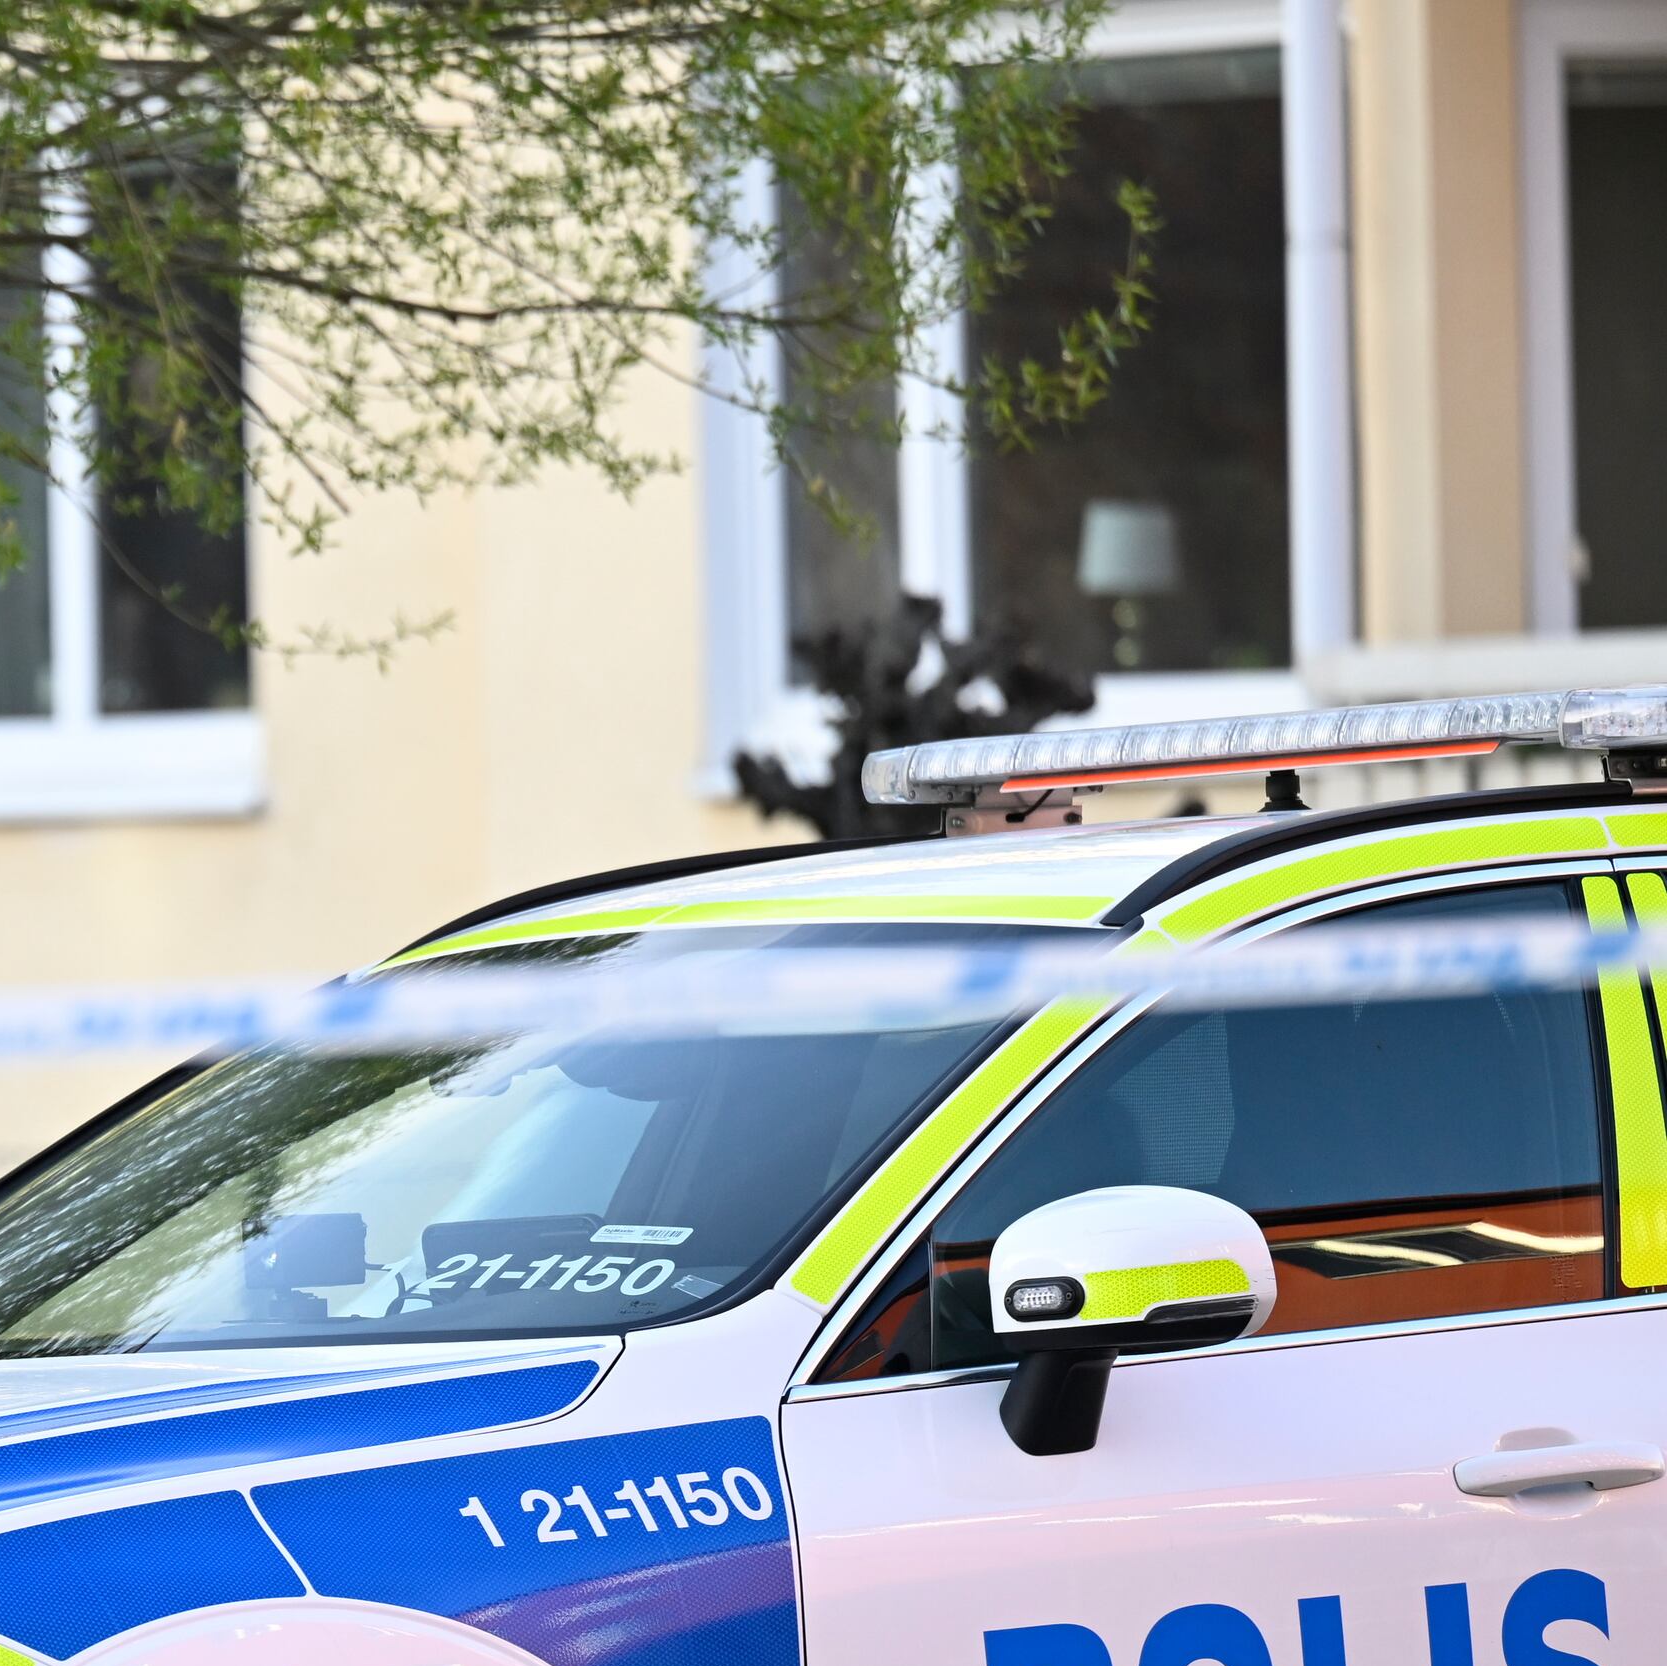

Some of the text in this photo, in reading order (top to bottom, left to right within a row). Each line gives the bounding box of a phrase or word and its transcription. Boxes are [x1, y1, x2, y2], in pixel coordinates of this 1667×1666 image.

[422, 1253, 676, 1296] 21-1150
[460, 1467, 774, 1548] 1 21-1150
